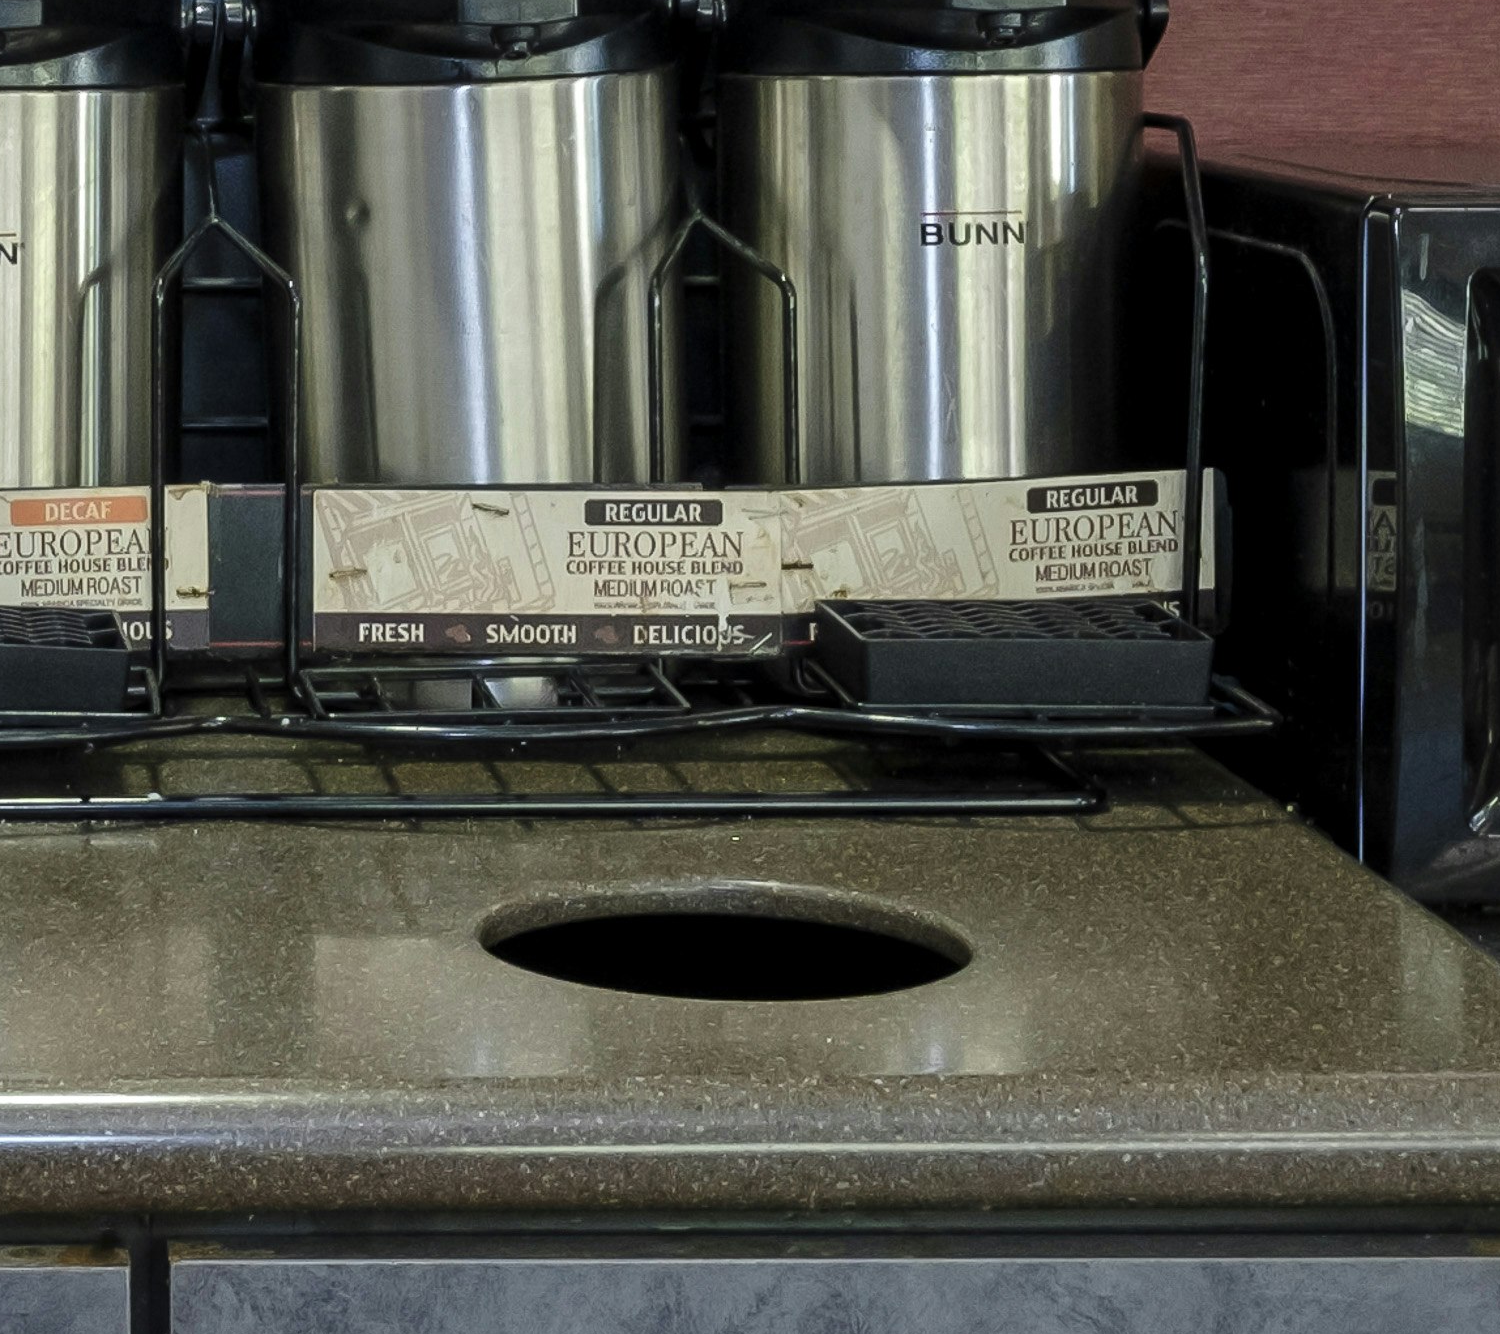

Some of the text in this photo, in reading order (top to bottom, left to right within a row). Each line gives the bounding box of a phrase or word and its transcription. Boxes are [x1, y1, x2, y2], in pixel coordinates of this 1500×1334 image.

[919, 222, 1026, 246] BUNN
[1046, 486, 1138, 509] REGULAR
[45, 501, 113, 522] DECAF
[605, 503, 702, 522] REGULAR
[1009, 510, 1178, 546] EUROPEAN
[567, 531, 744, 559] EUROPEAN
[1009, 538, 1179, 562] COFFEE HOUSE BLEND
[58, 558, 111, 574] HOUSE
[566, 560, 744, 575] COFFEE HOUSE BLEND
[1035, 558, 1152, 582] MEDIUM ROAST
[20, 576, 142, 598] MEDIUM ROAST
[594, 579, 716, 597] MEDIUM ROAST
[358, 622, 424, 643] FRESH
[486, 623, 577, 644] SMOOTH
